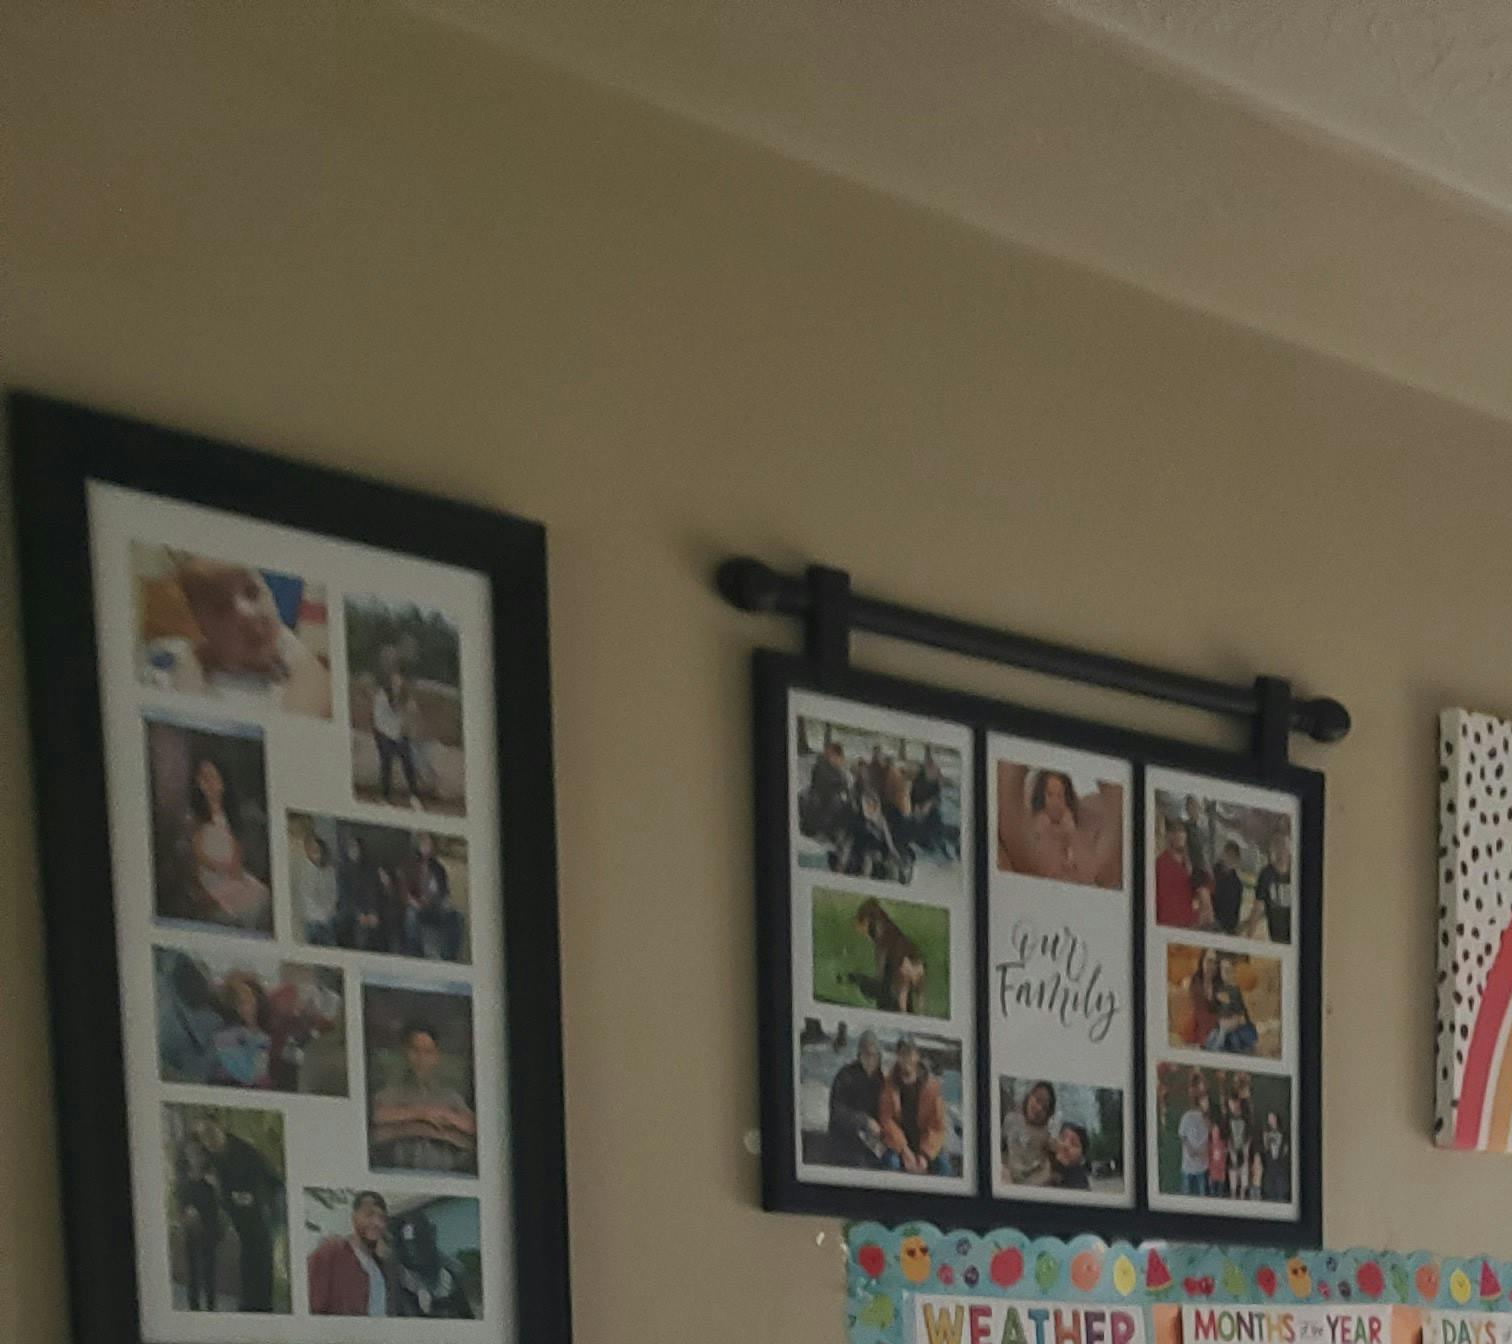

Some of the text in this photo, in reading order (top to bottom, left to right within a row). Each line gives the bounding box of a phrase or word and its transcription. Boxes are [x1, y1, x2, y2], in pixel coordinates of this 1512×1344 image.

[995, 964, 1120, 1043] Family
[1195, 1310, 1382, 1344] MONTHS YEAR
